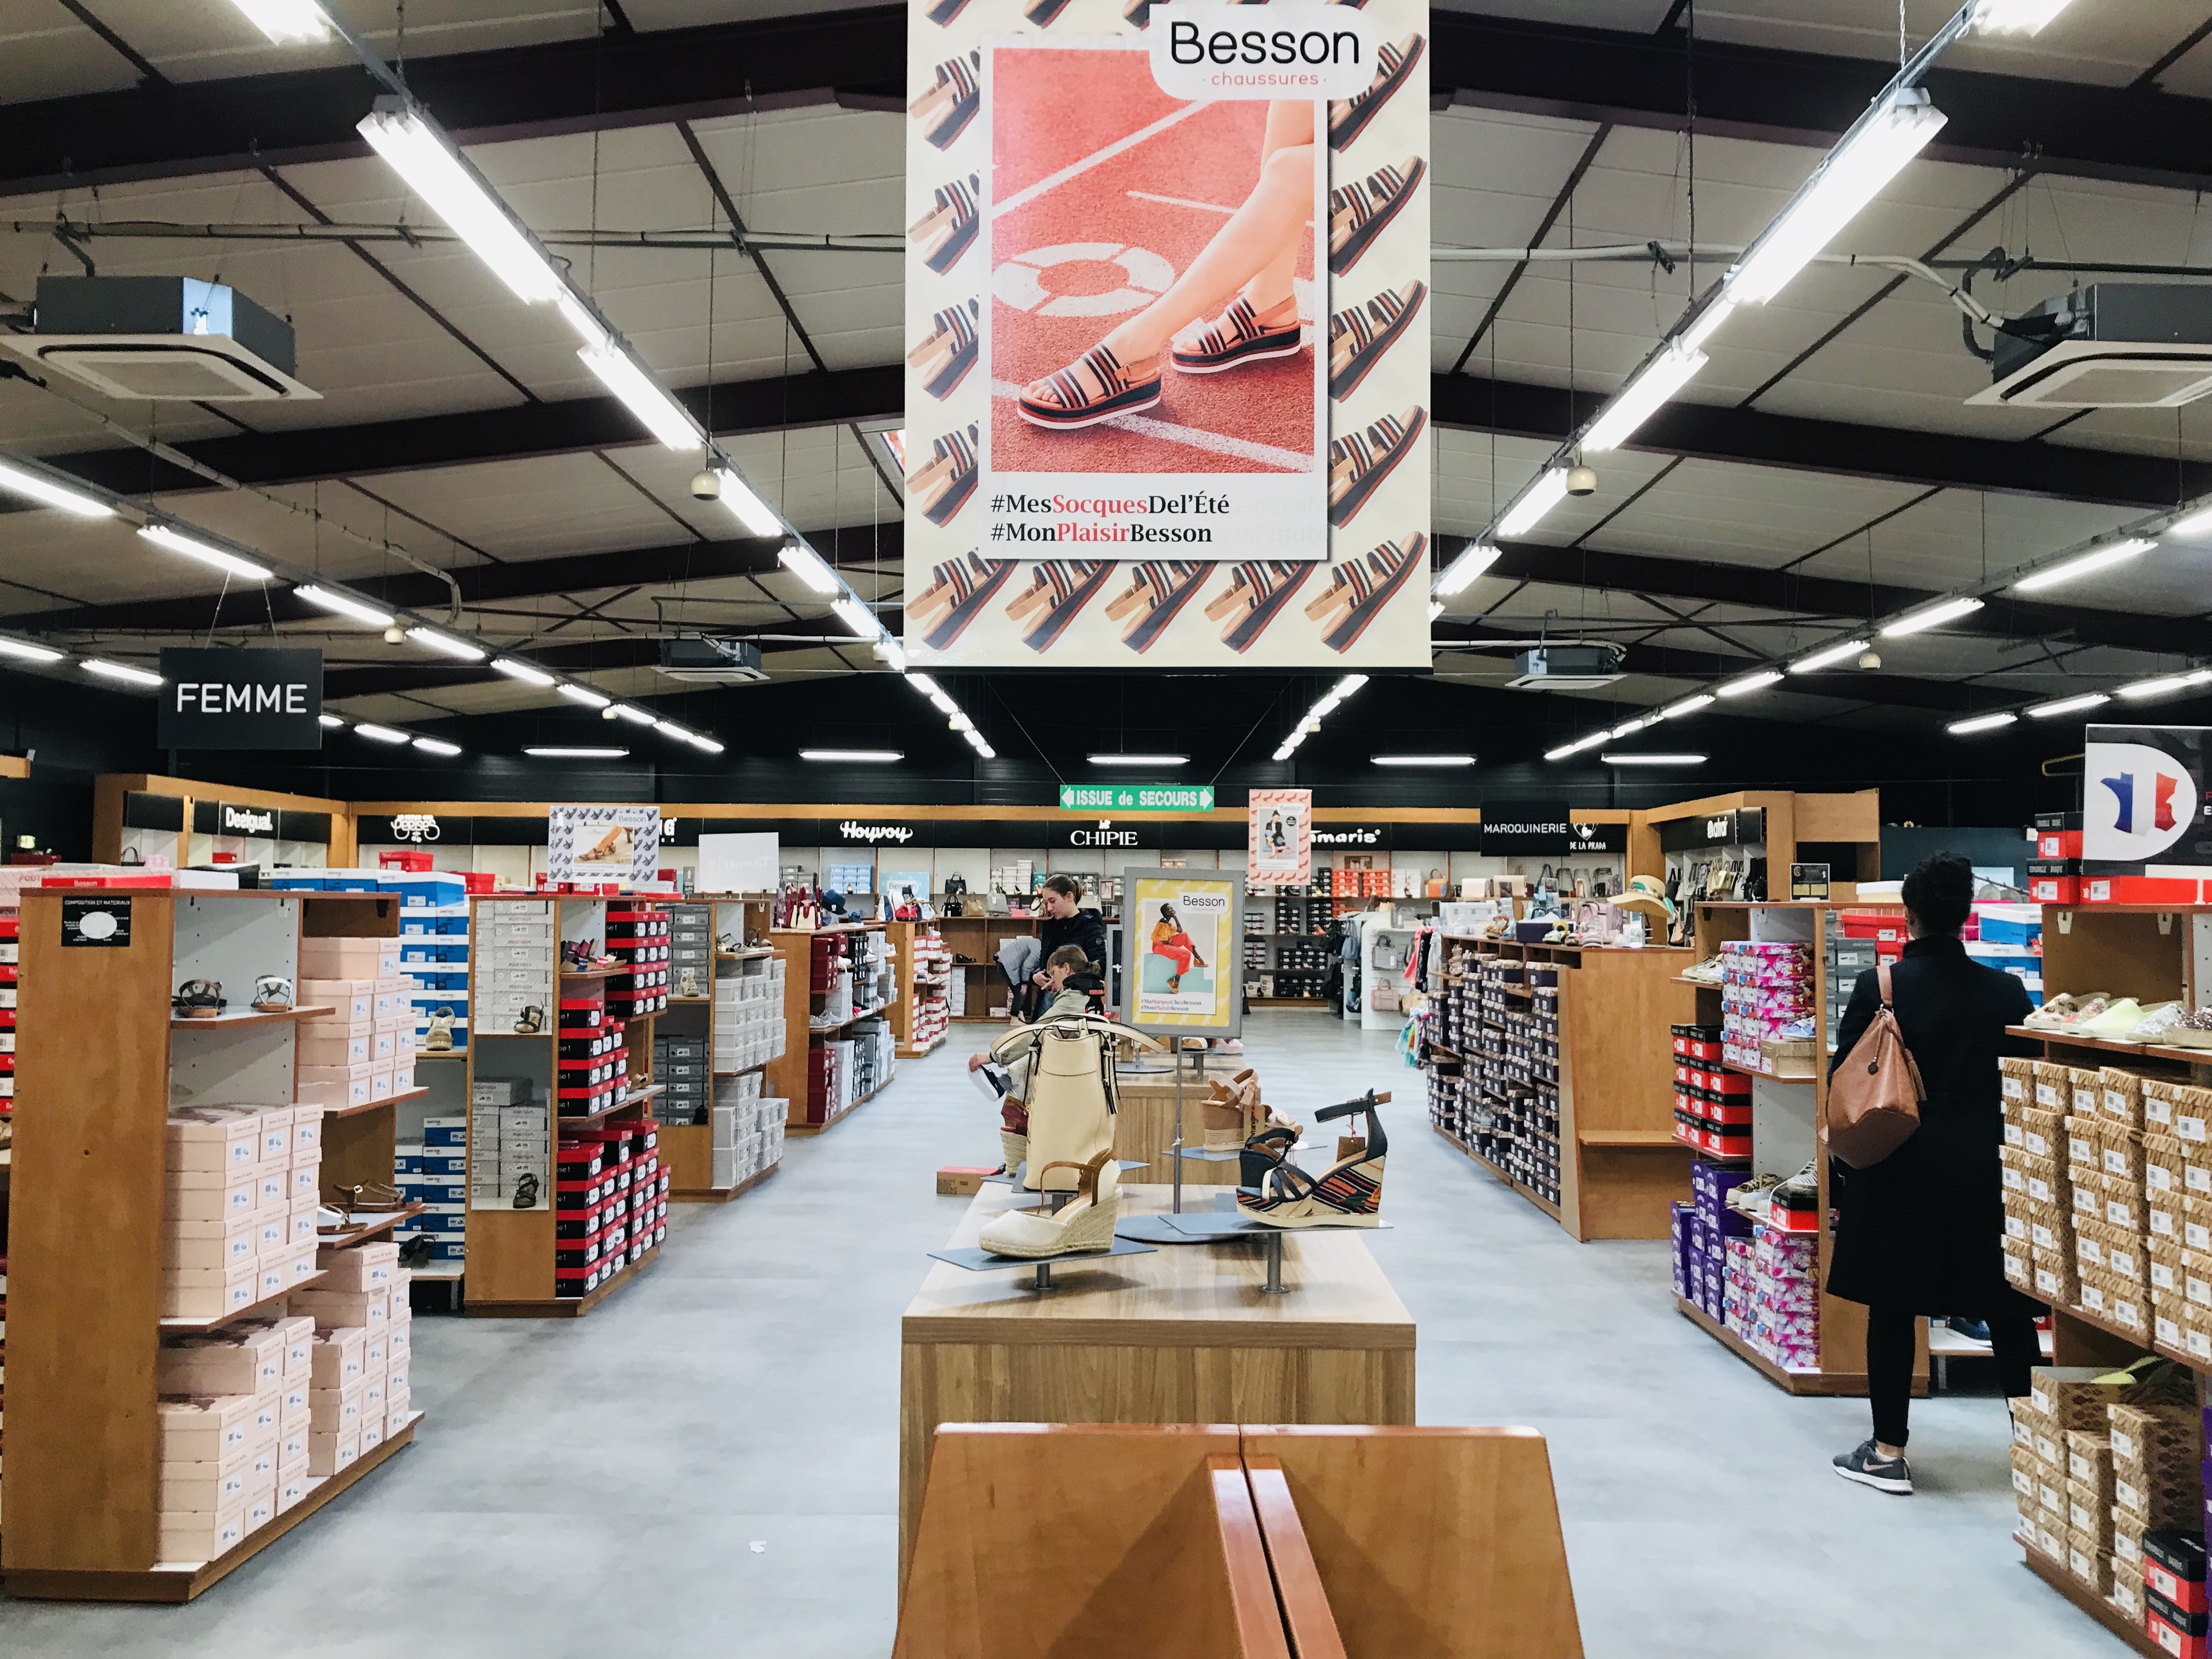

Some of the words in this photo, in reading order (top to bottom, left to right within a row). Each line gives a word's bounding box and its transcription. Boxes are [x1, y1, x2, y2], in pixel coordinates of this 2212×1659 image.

[1171, 21, 1359, 65] Besson
[1211, 71, 1319, 86] chaussures
[990, 522, 1212, 543] #MonPlaisirBesson
[177, 683, 307, 713] FEMME
[1076, 790, 1113, 805] ISSUE
[1118, 791, 1133, 806] de
[1139, 791, 1198, 806] SECOURS
[839, 821, 913, 843] Hoyvoy
[1311, 828, 1376, 843] maris
[1484, 823, 1567, 833] MAROQUINERIE
[1070, 830, 1138, 845] CHIPIE
[1578, 841, 1587, 850] LA
[1588, 841, 1606, 850] PRADA
[1183, 895, 1225, 906] Besson
